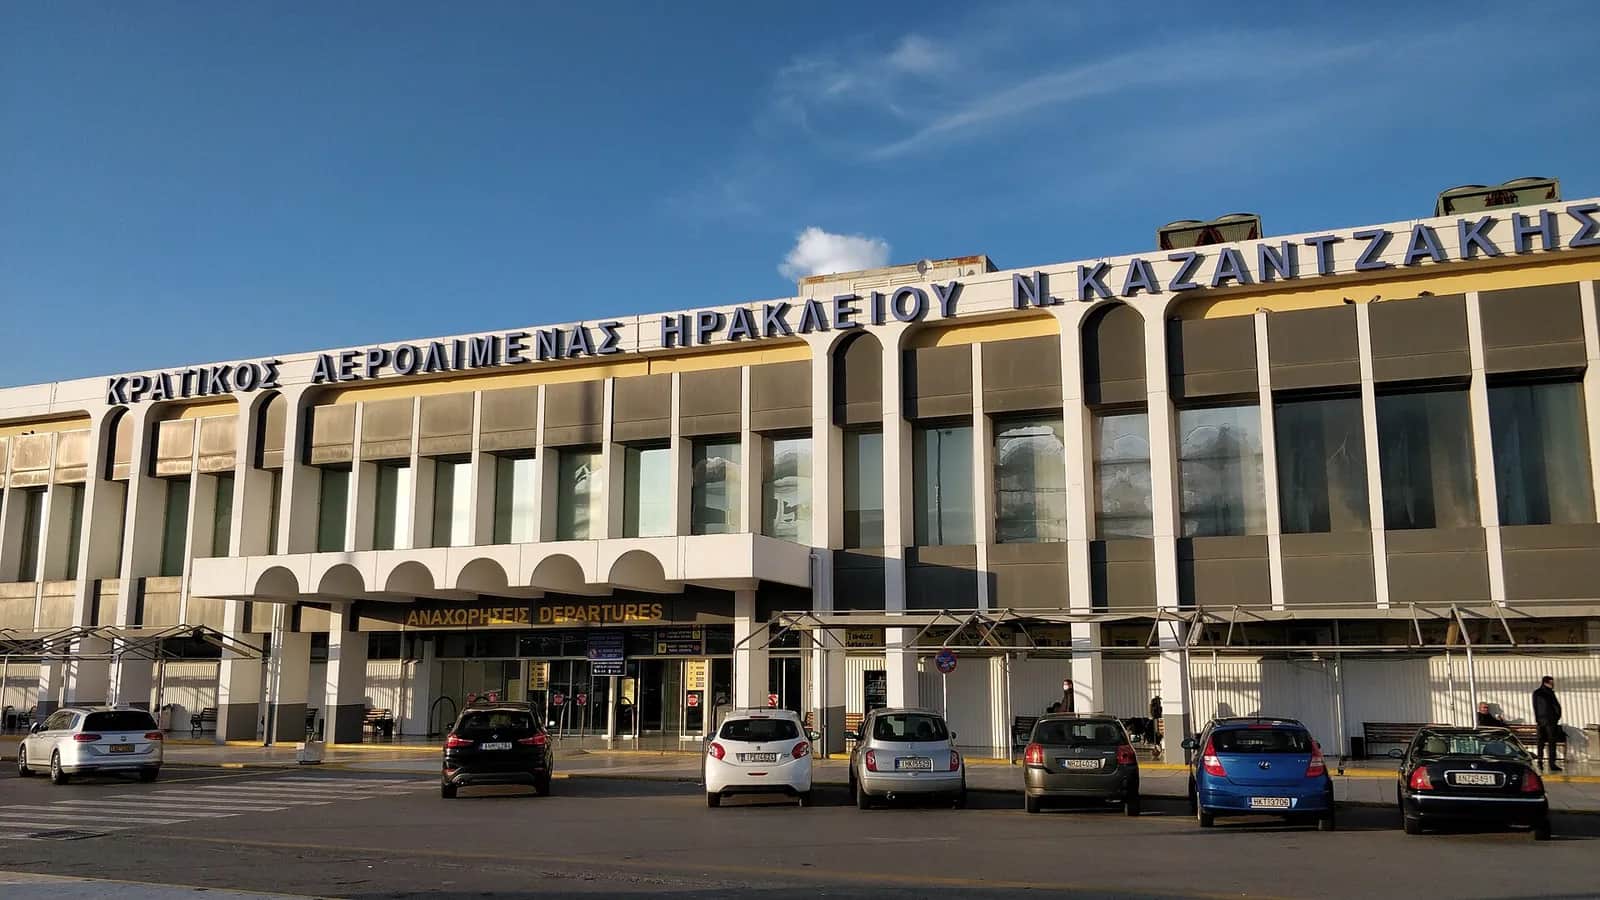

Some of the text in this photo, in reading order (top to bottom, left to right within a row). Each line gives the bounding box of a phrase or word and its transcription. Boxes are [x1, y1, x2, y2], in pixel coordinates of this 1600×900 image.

[106, 358, 282, 405] ΚΡΑΤΙΚΟΣ
[311, 321, 622, 384] ΑΕΡΟΛΙΜΕΝΑΣ
[661, 281, 963, 348] ΗΡΑΚΛΕΙΟΥ
[1077, 203, 1600, 302] ΚΑΖΑΝΤΖΑΚΗΣ
[407, 603, 664, 626] ΑΝΑΧΩΡΗΣΕΙΣ DEPARTURES
